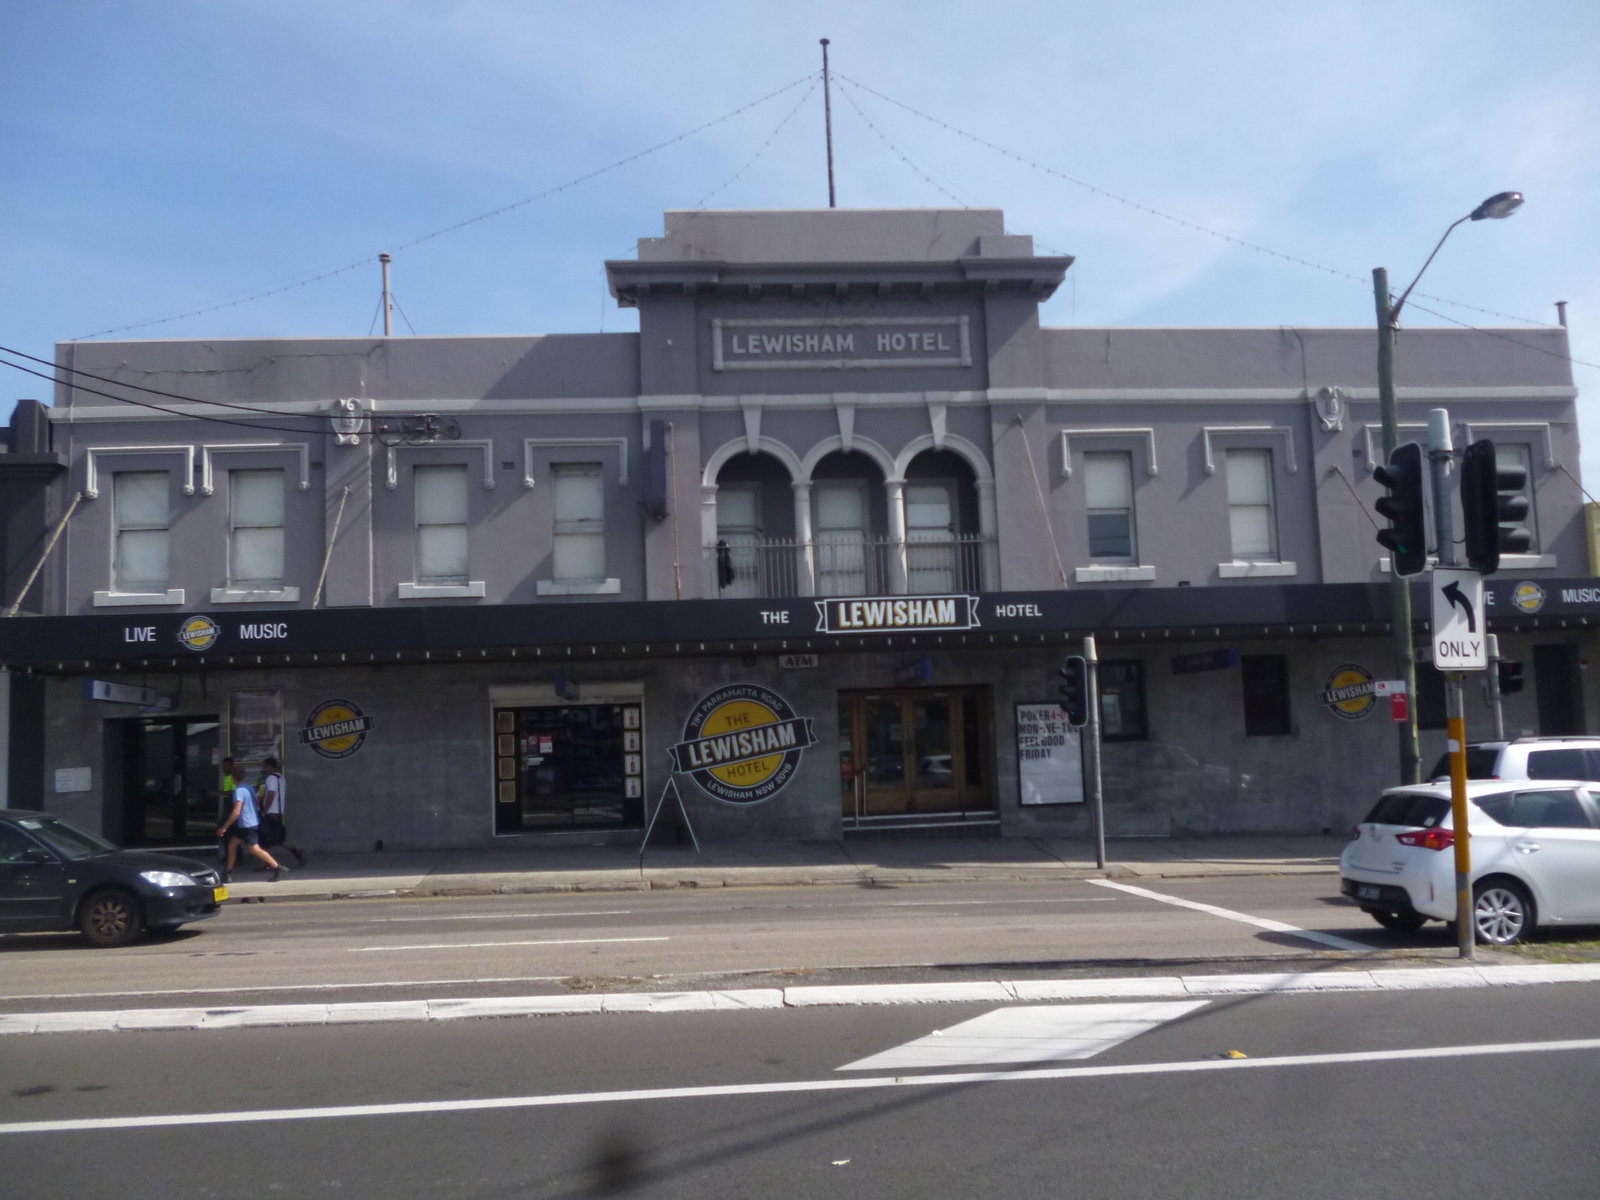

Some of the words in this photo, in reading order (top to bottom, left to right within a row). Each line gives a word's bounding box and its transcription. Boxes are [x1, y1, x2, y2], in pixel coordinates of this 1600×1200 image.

[733, 333, 853, 353] LEWISHAM
[877, 332, 951, 351] HOTEL
[1561, 588, 1600, 603] MUSIC
[761, 611, 790, 625] THE
[839, 600, 957, 628] LEWISHAM
[996, 604, 1043, 621] HOTEL
[125, 626, 157, 642] LIVE
[240, 623, 287, 639] MUSIC
[1440, 641, 1480, 657] ONLY
[785, 656, 813, 666] ATM
[703, 688, 758, 712] PARRAMATTA
[760, 693, 783, 711] ROAD
[725, 712, 751, 727] THE
[1021, 710, 1050, 722] POKER
[308, 719, 365, 740] LEWISHAM
[688, 723, 797, 767] LEWISHAM
[1020, 749, 1051, 760] FRIDAY
[727, 760, 769, 778] HOTEL
[707, 780, 753, 799] LEWISHAM
[756, 783, 775, 798] NSW
